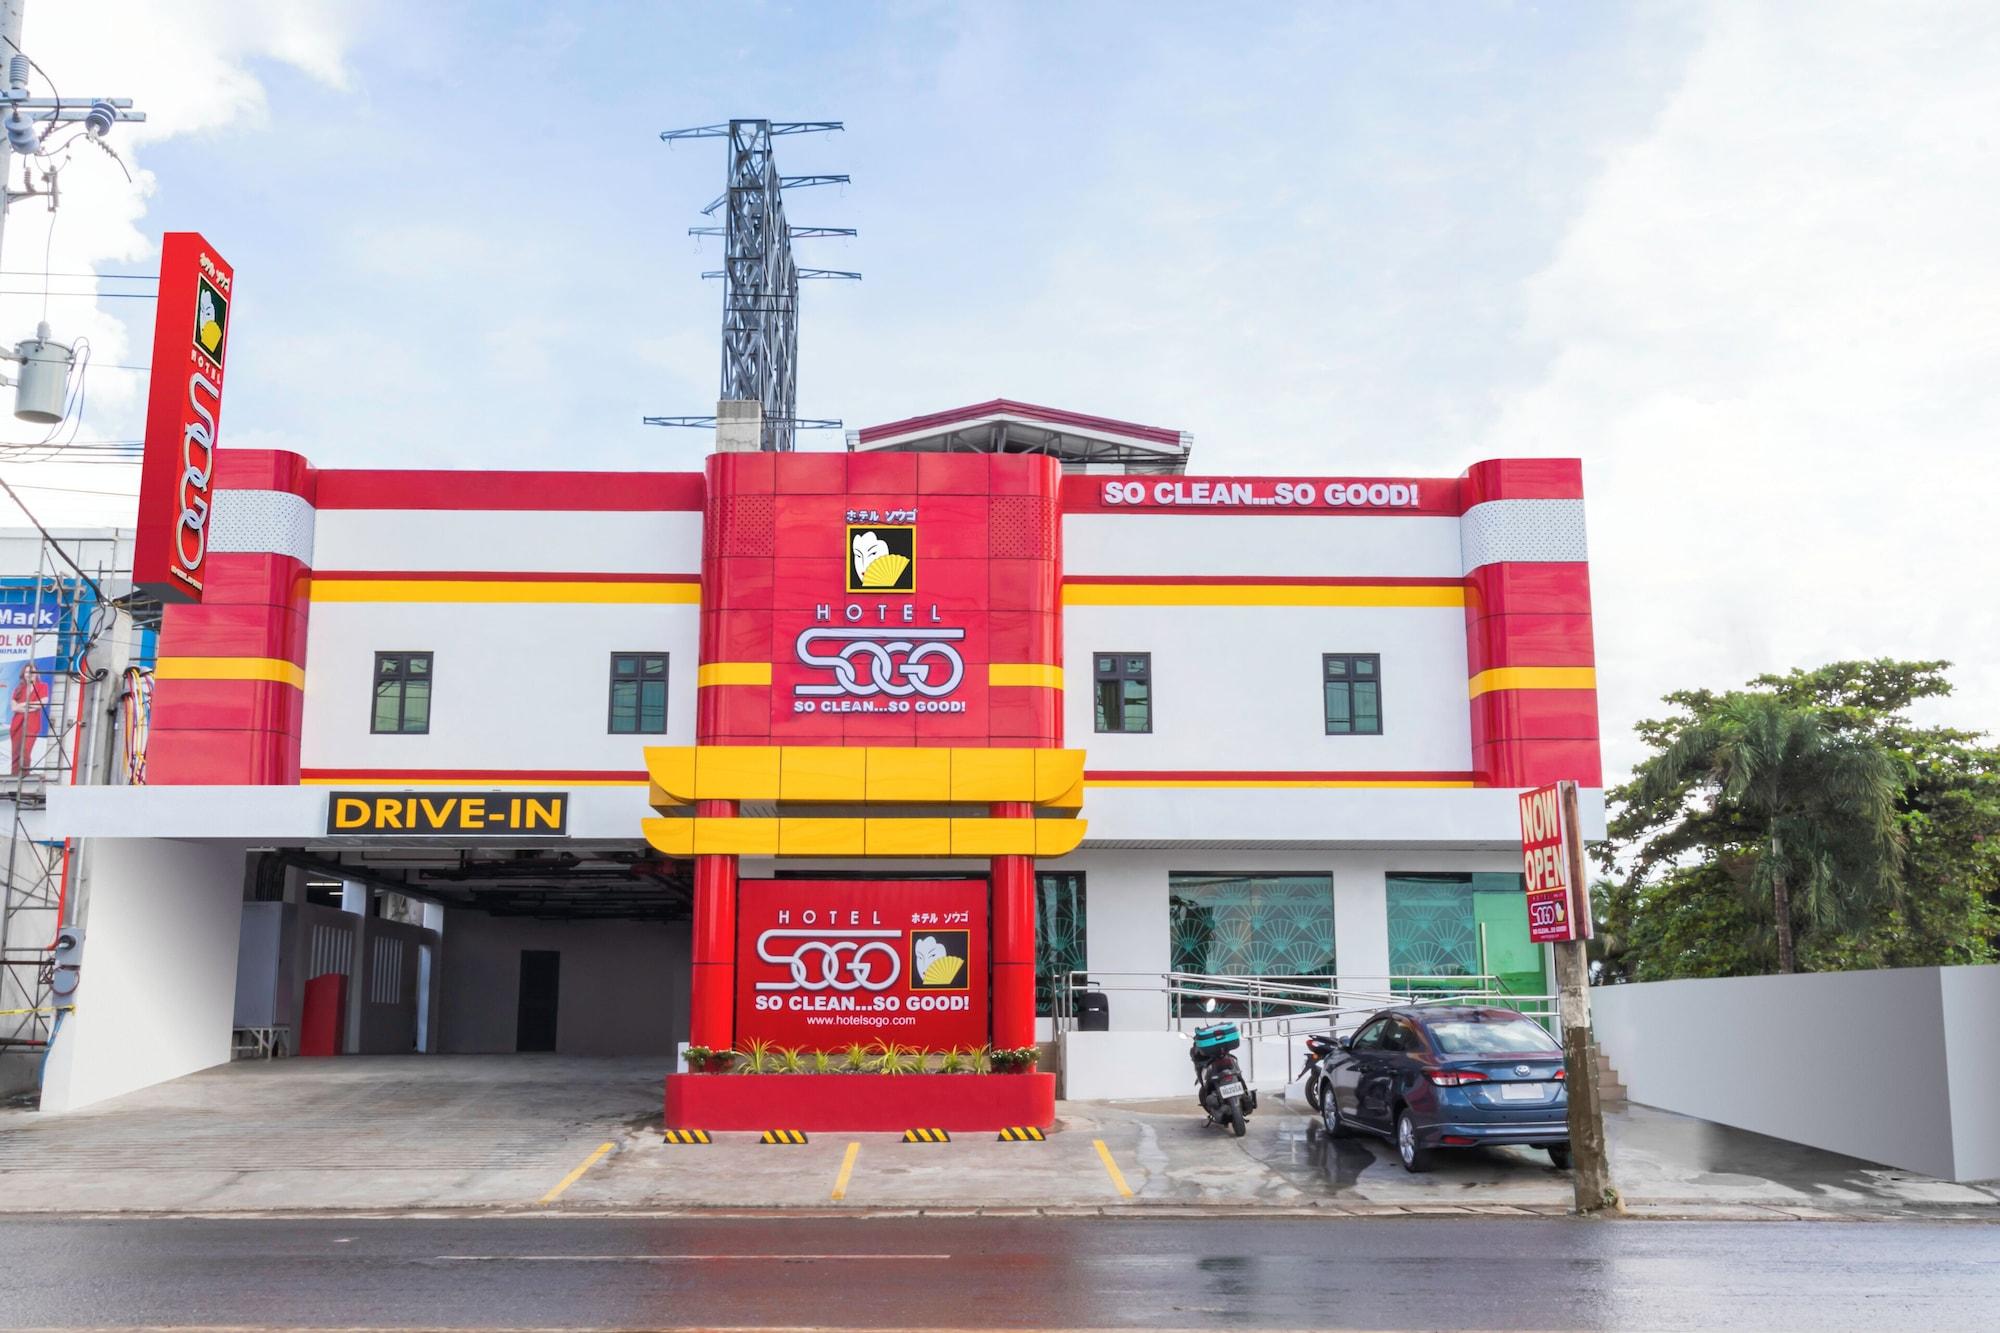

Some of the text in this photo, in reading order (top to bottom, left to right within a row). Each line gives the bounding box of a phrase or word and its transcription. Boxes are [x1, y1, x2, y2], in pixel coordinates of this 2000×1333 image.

[175, 371, 220, 571] SOGO
[1104, 482, 1419, 507] SO CLEAN...SO GOOD!
[846, 510, 879, 522] ホテル
[815, 604, 943, 622] HOTEL
[794, 627, 966, 698] SOGO
[793, 700, 966, 713] SO CLEAN...SO GOOD!
[335, 798, 561, 829] DRIVE-IN
[1521, 788, 1558, 845] NOW
[1524, 843, 1566, 892] OPEN
[779, 910, 881, 925] HOTEL
[911, 911, 969, 924] ホテル ソウゴ
[755, 929, 902, 991] SOGO
[755, 996, 970, 1011] SO CLEAN...SO GOOD!
[807, 1015, 916, 1027] www.hotelsogo.com
